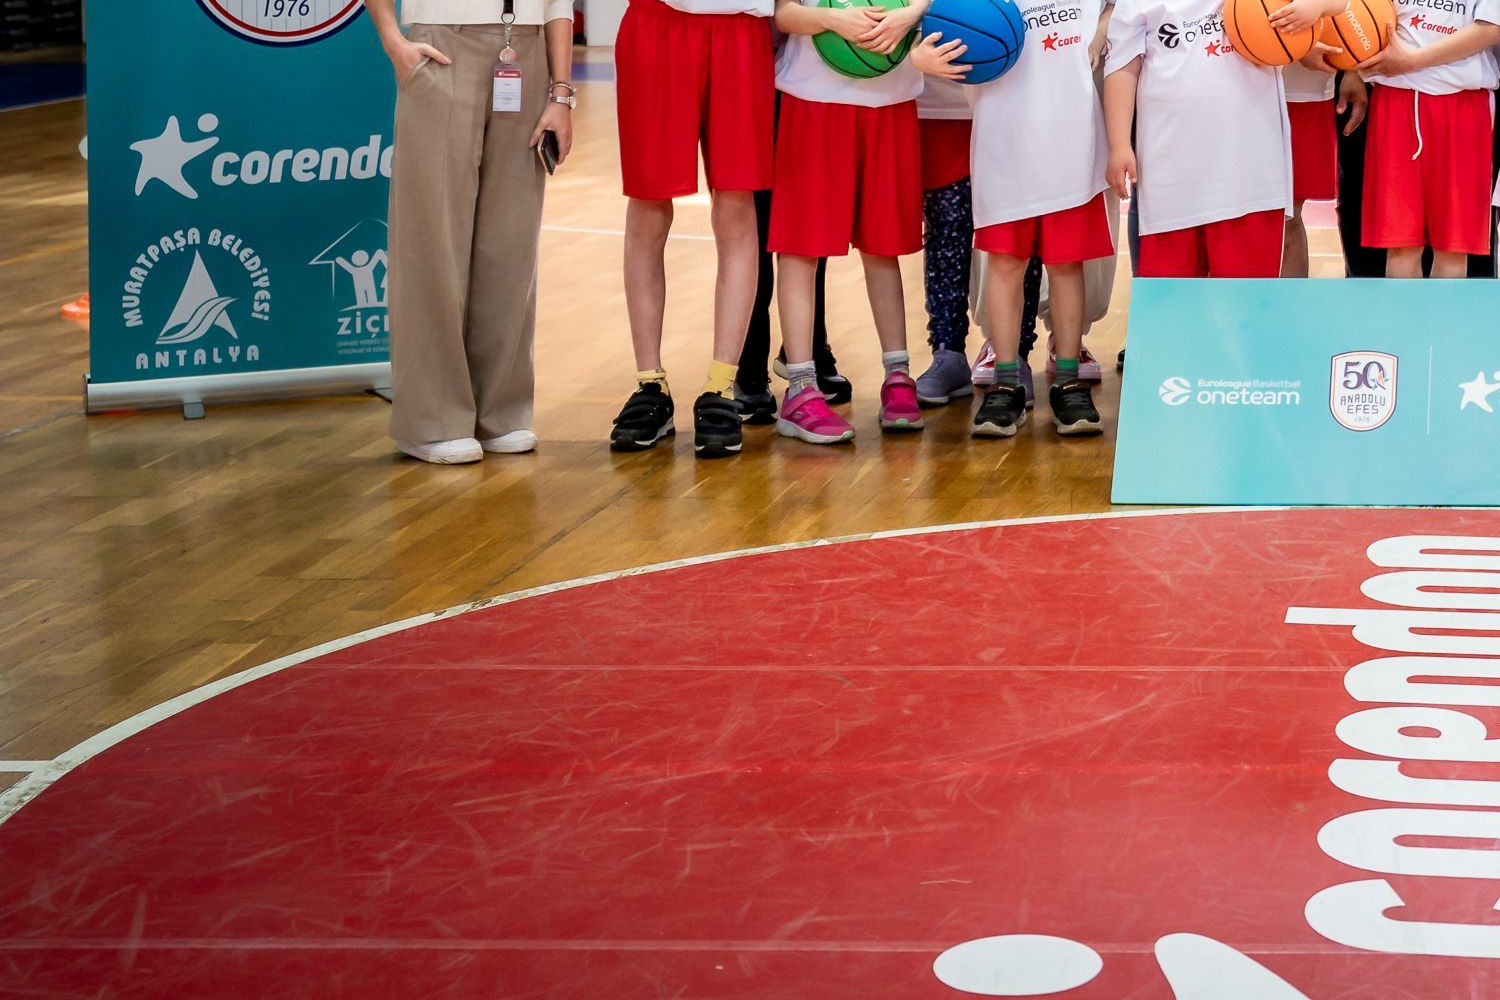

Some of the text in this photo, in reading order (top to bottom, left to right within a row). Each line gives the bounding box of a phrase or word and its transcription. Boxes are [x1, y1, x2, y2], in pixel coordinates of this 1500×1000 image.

[1345, 8, 1372, 51] motorola
[1421, 21, 1458, 36] corend
[210, 134, 394, 187] corend
[122, 226, 272, 328] MURATPAŞA BELEDİYESİ
[336, 311, 390, 339] ZİÇ
[135, 344, 260, 370] ANTALYA
[1197, 378, 1252, 390] Euroleague
[1342, 360, 1386, 390] 50
[1196, 387, 1301, 405] oneteam
[1340, 393, 1386, 407] ANADOLU
[1347, 404, 1379, 415] EFES
